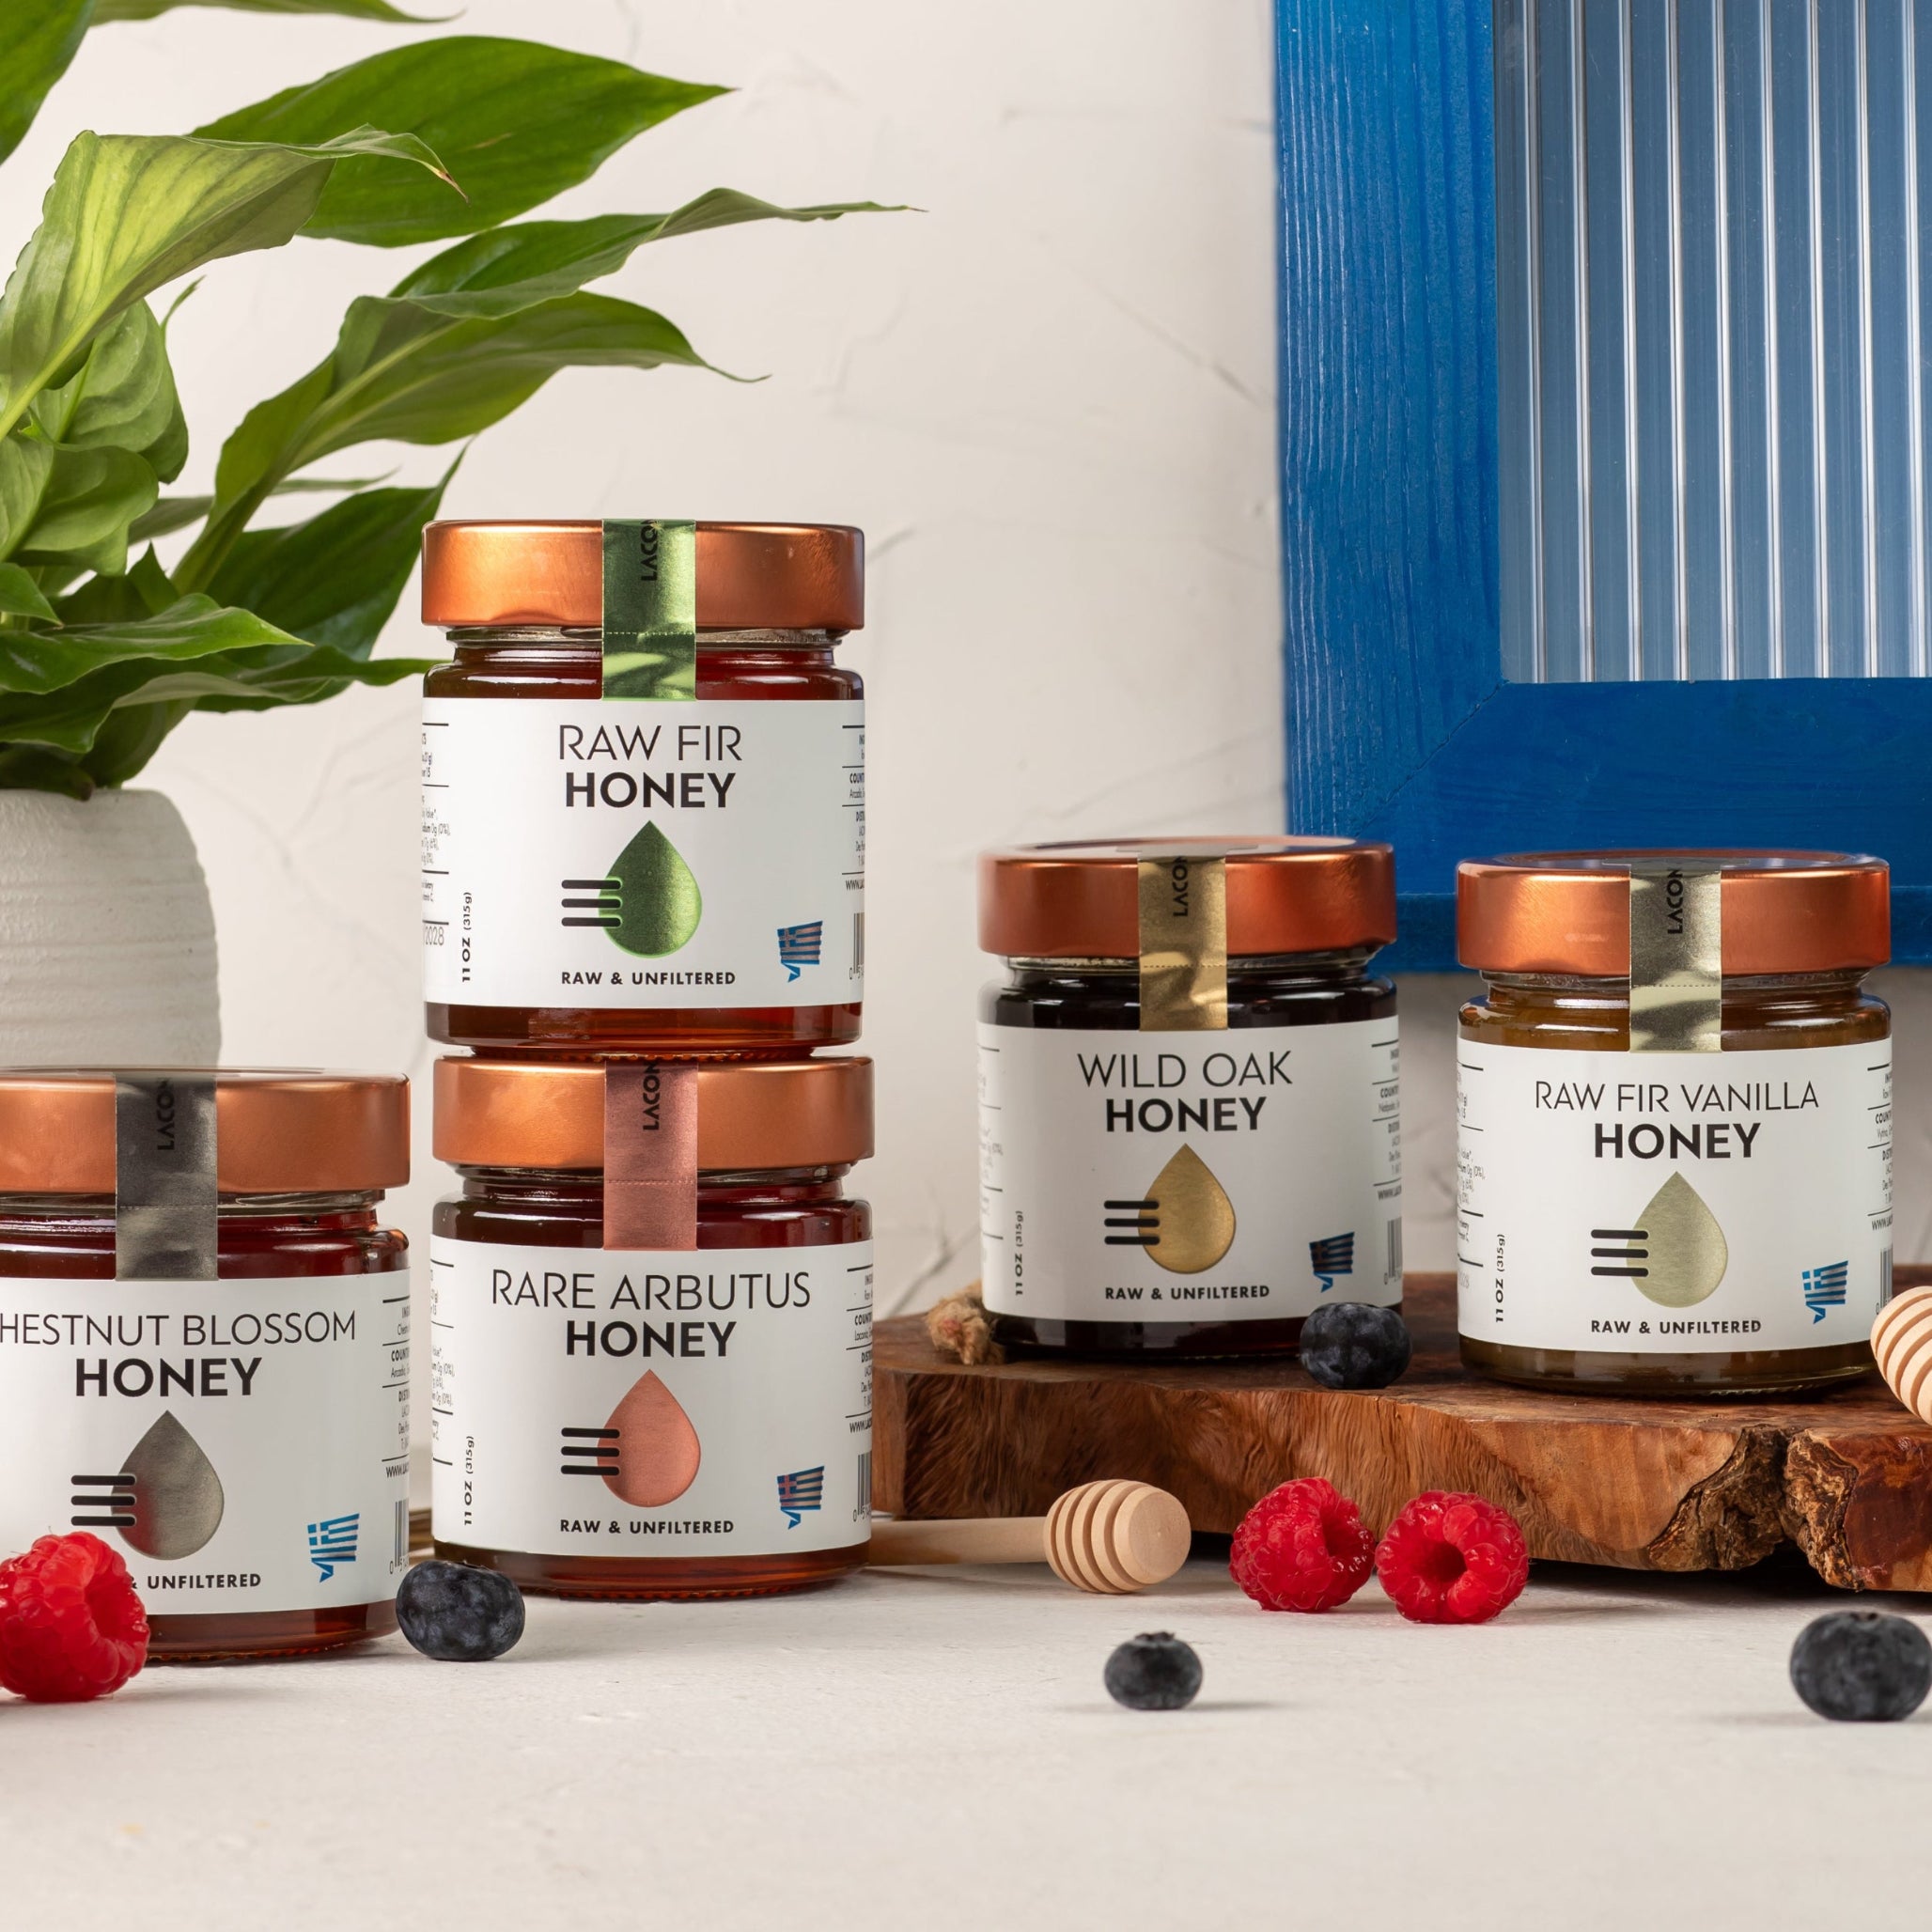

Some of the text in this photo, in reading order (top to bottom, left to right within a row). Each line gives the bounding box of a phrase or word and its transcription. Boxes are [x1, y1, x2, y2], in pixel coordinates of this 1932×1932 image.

[559, 724, 742, 761] RAW FIR
[566, 771, 737, 809] HONEY
[461, 892, 473, 983] 11 OZ (315g)
[561, 972, 736, 986] RAW & UNFILTERED
[1077, 1050, 1293, 1088] WILD OAK
[1106, 1096, 1267, 1133] HONEY
[1535, 1081, 1819, 1113] RAW FIR VANILLA
[1595, 1122, 1761, 1160] HONEY
[1014, 1254, 1023, 1278] OZ
[1495, 1234, 1505, 1322] 11 OZ (315g)
[492, 1269, 811, 1311] RARE ARBUTUS
[1015, 1282, 1023, 1295] 11
[1105, 1285, 1270, 1301] RAW & UNFILTERED
[0, 1310, 355, 1347] HESTNUT BLOSSOM
[567, 1319, 737, 1358] HONEY
[1591, 1319, 1762, 1334] RAW & UNFILTERED
[76, 1357, 263, 1398] HONEY
[464, 1436, 475, 1525] 11 OZ (315g)
[560, 1519, 734, 1535] RAW & UNFILTERED
[147, 1573, 261, 1590] UNFILTERED
